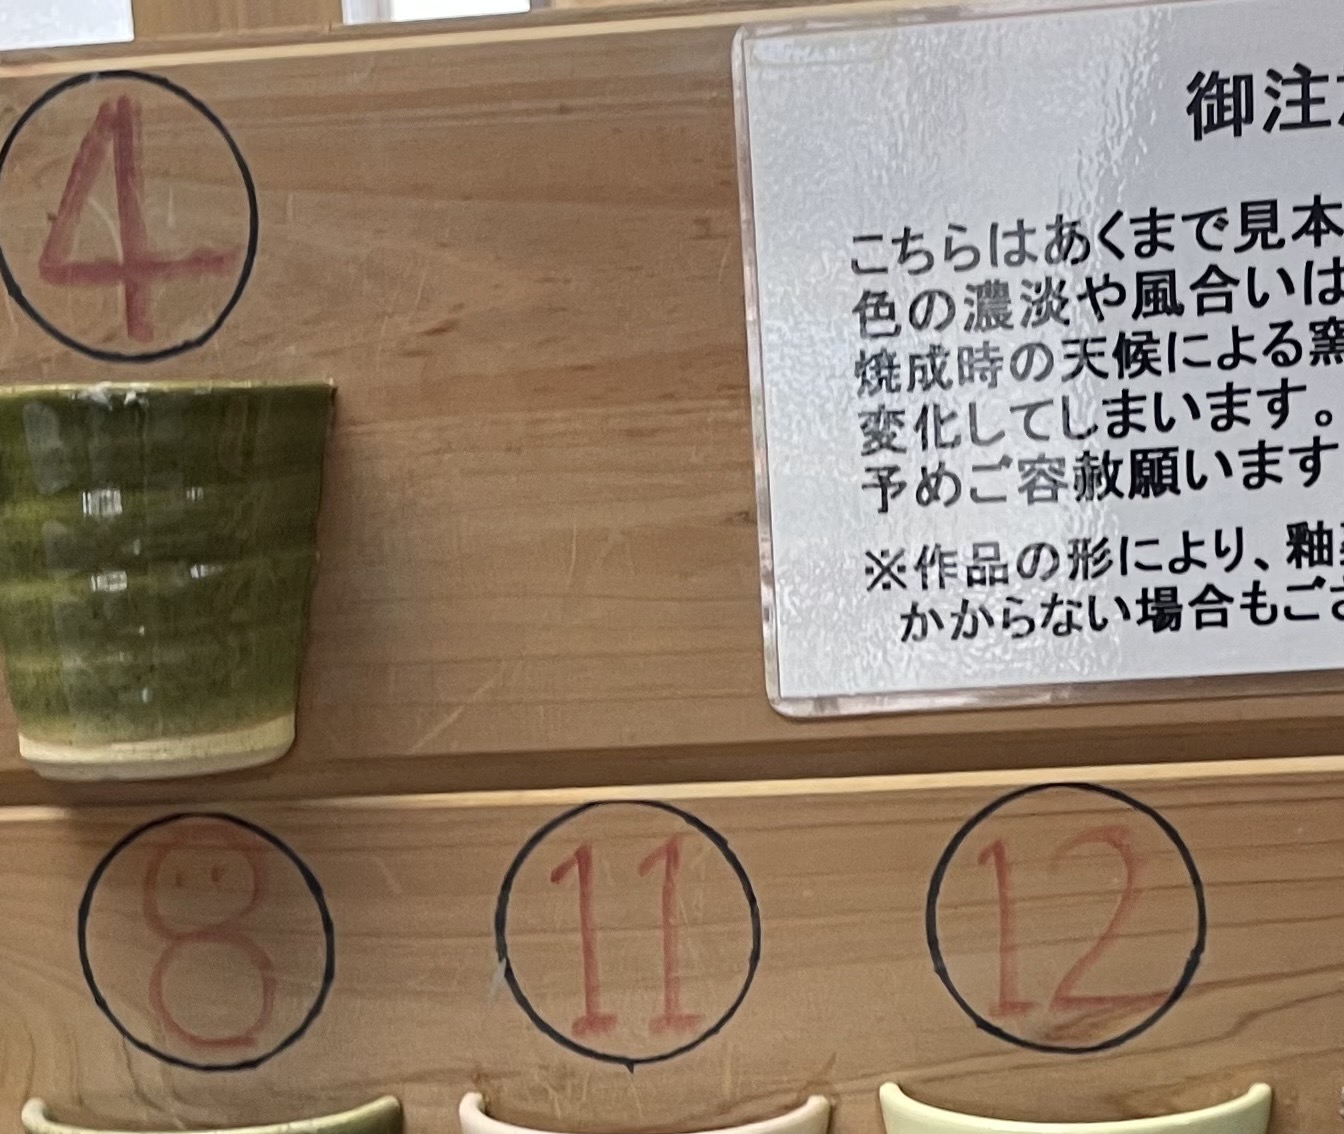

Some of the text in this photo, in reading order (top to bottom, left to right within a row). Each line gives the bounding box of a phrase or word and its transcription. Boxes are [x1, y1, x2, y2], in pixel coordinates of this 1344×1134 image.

[39, 95, 242, 342] 4
[858, 377, 1334, 457] 変化してしまいます。
[143, 817, 276, 1049] 8
[549, 832, 705, 1037] 11
[977, 823, 1189, 1016] 12
